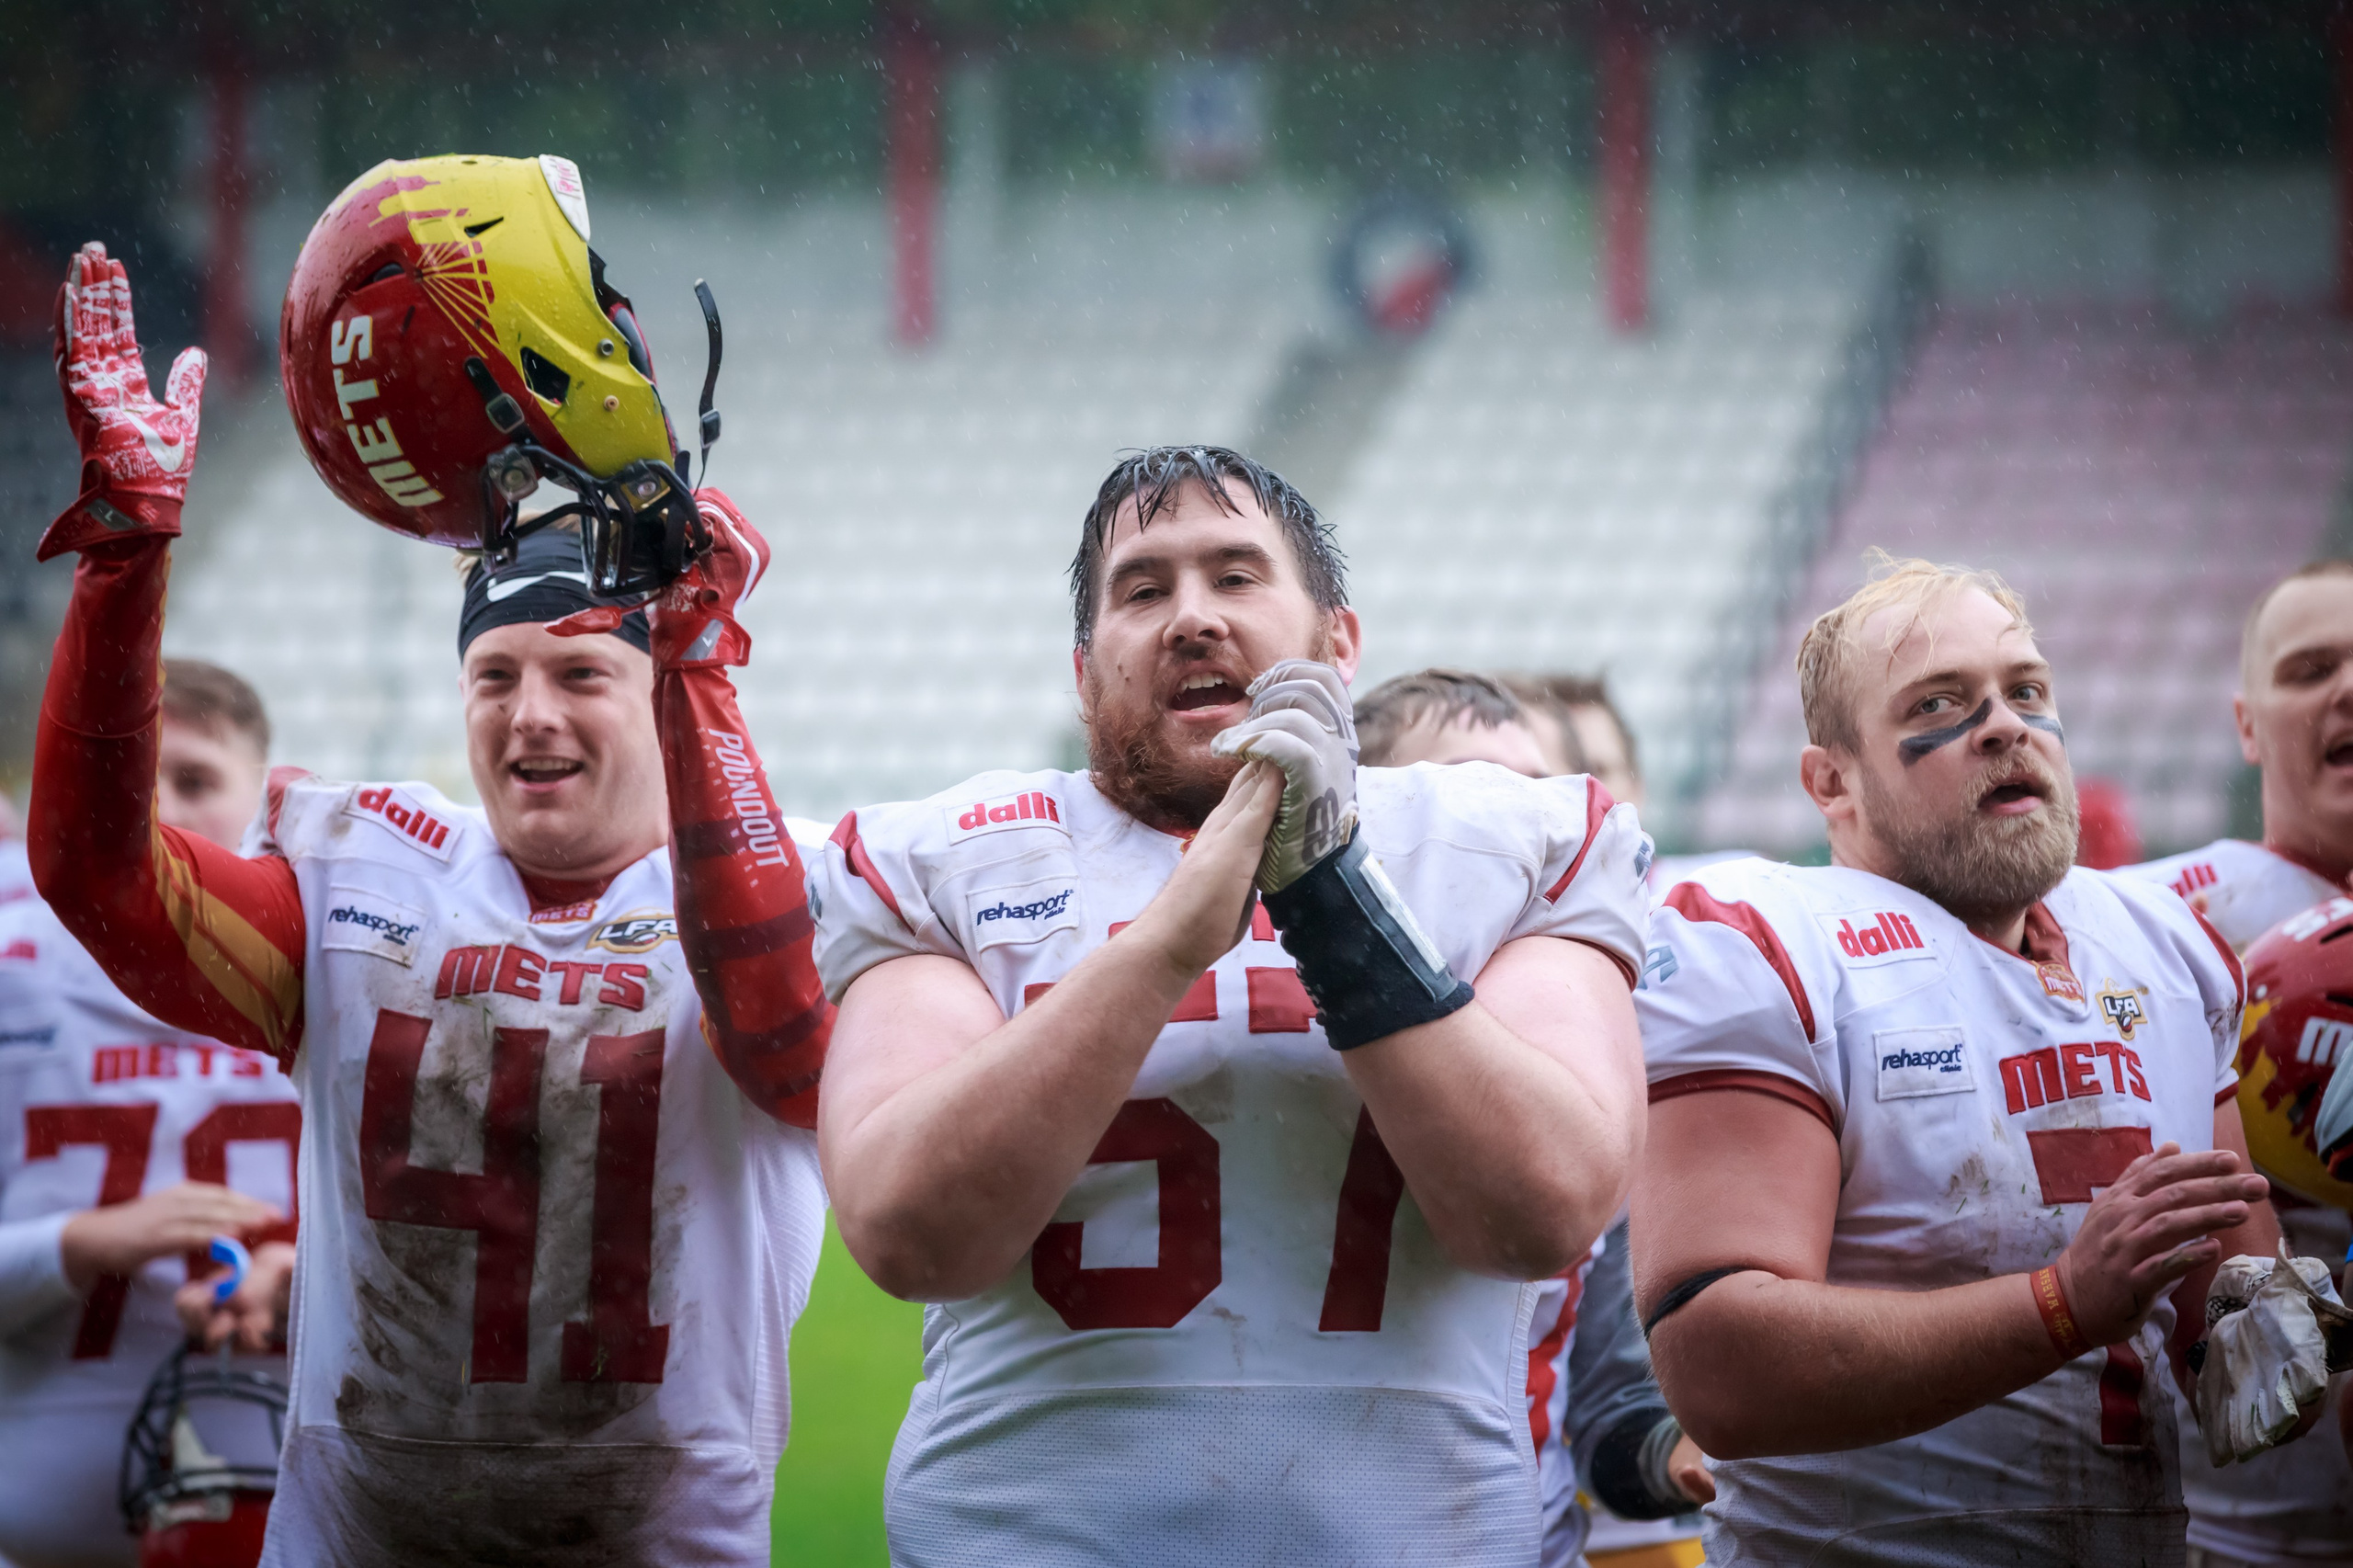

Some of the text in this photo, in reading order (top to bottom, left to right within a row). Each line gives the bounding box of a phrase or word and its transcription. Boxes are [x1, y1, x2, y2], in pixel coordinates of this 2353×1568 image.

[331, 315, 445, 506] METS
[358, 787, 450, 850] dalli
[708, 728, 790, 867] POUNDOUT
[958, 791, 1061, 831] dalli
[1836, 912, 1925, 958] dalli
[434, 944, 649, 1012] METS
[2104, 997, 2140, 1016] LFA
[93, 1043, 264, 1083] METS
[1998, 1040, 2153, 1116] METS
[359, 1007, 670, 1384] 41
